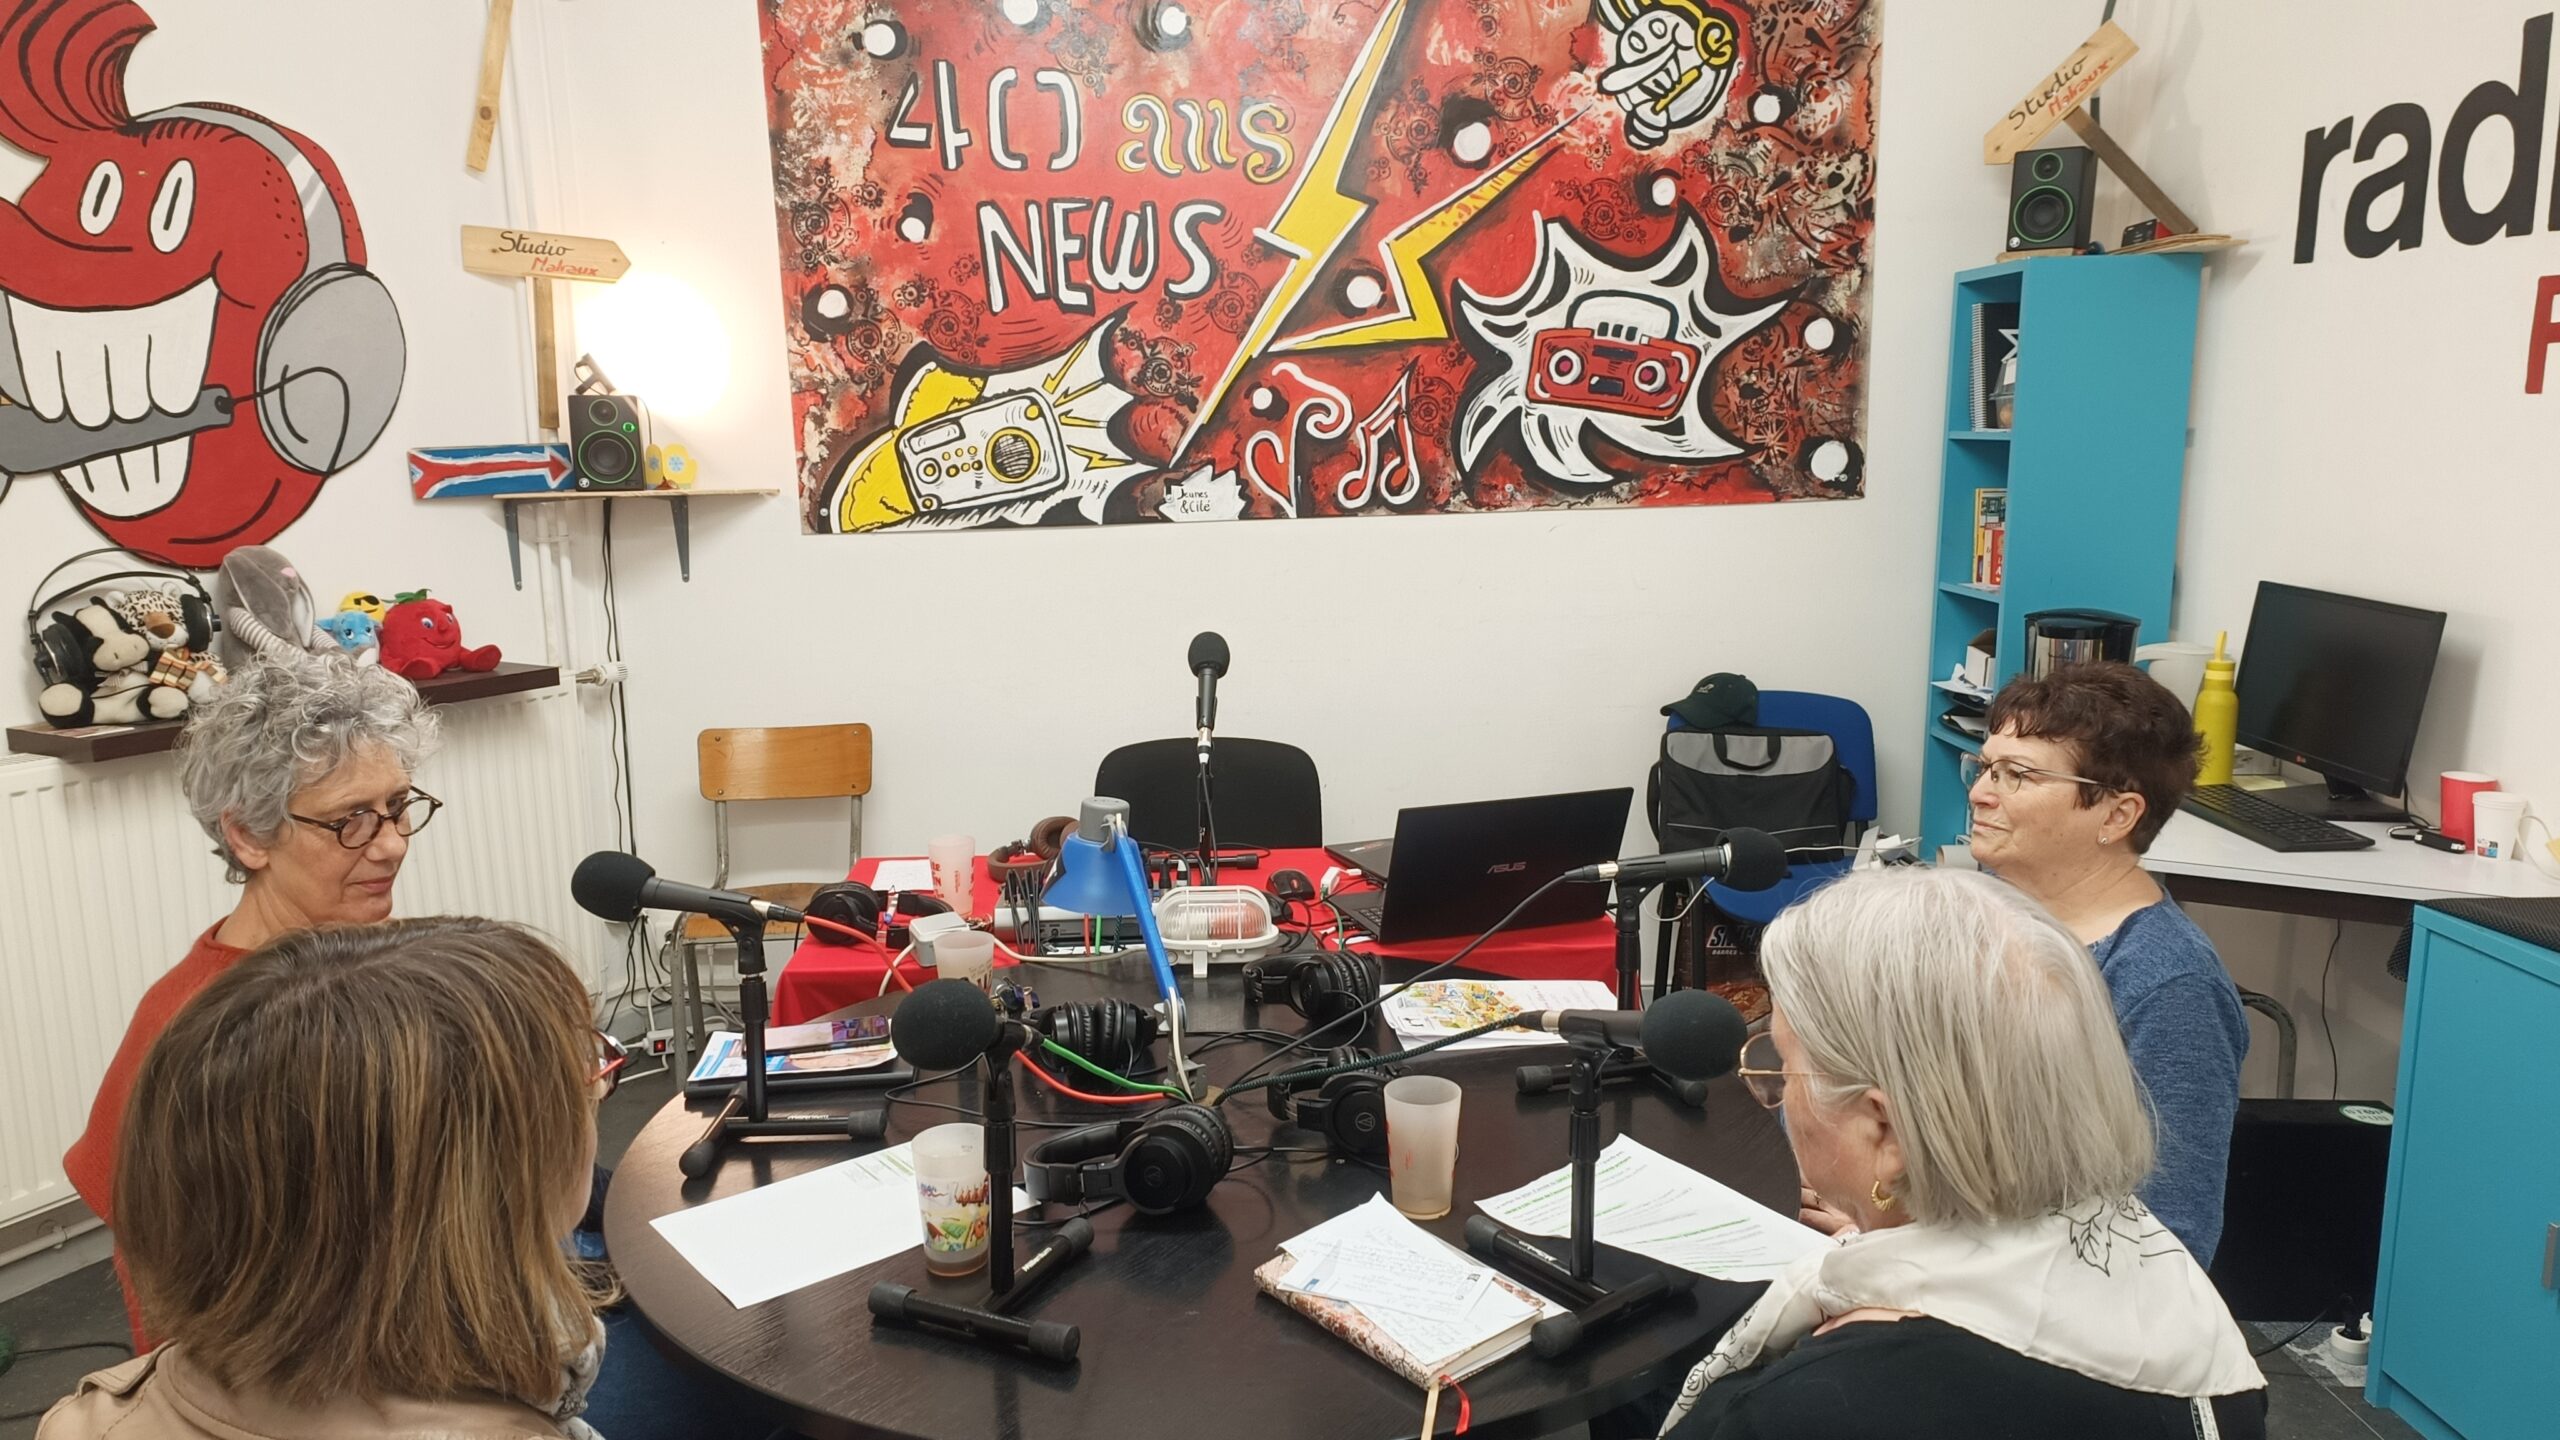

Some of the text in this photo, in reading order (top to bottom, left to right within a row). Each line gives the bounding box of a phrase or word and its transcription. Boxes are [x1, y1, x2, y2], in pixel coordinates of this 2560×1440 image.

[2008, 54, 2088, 130] Studio
[886, 59, 1296, 184] 40 ans
[498, 231, 574, 256] Studio
[531, 257, 598, 276] Malraux
[977, 197, 1227, 316] NEWS
[1177, 488, 1208, 500] Jeunes
[1487, 861, 1527, 874] ASUS
